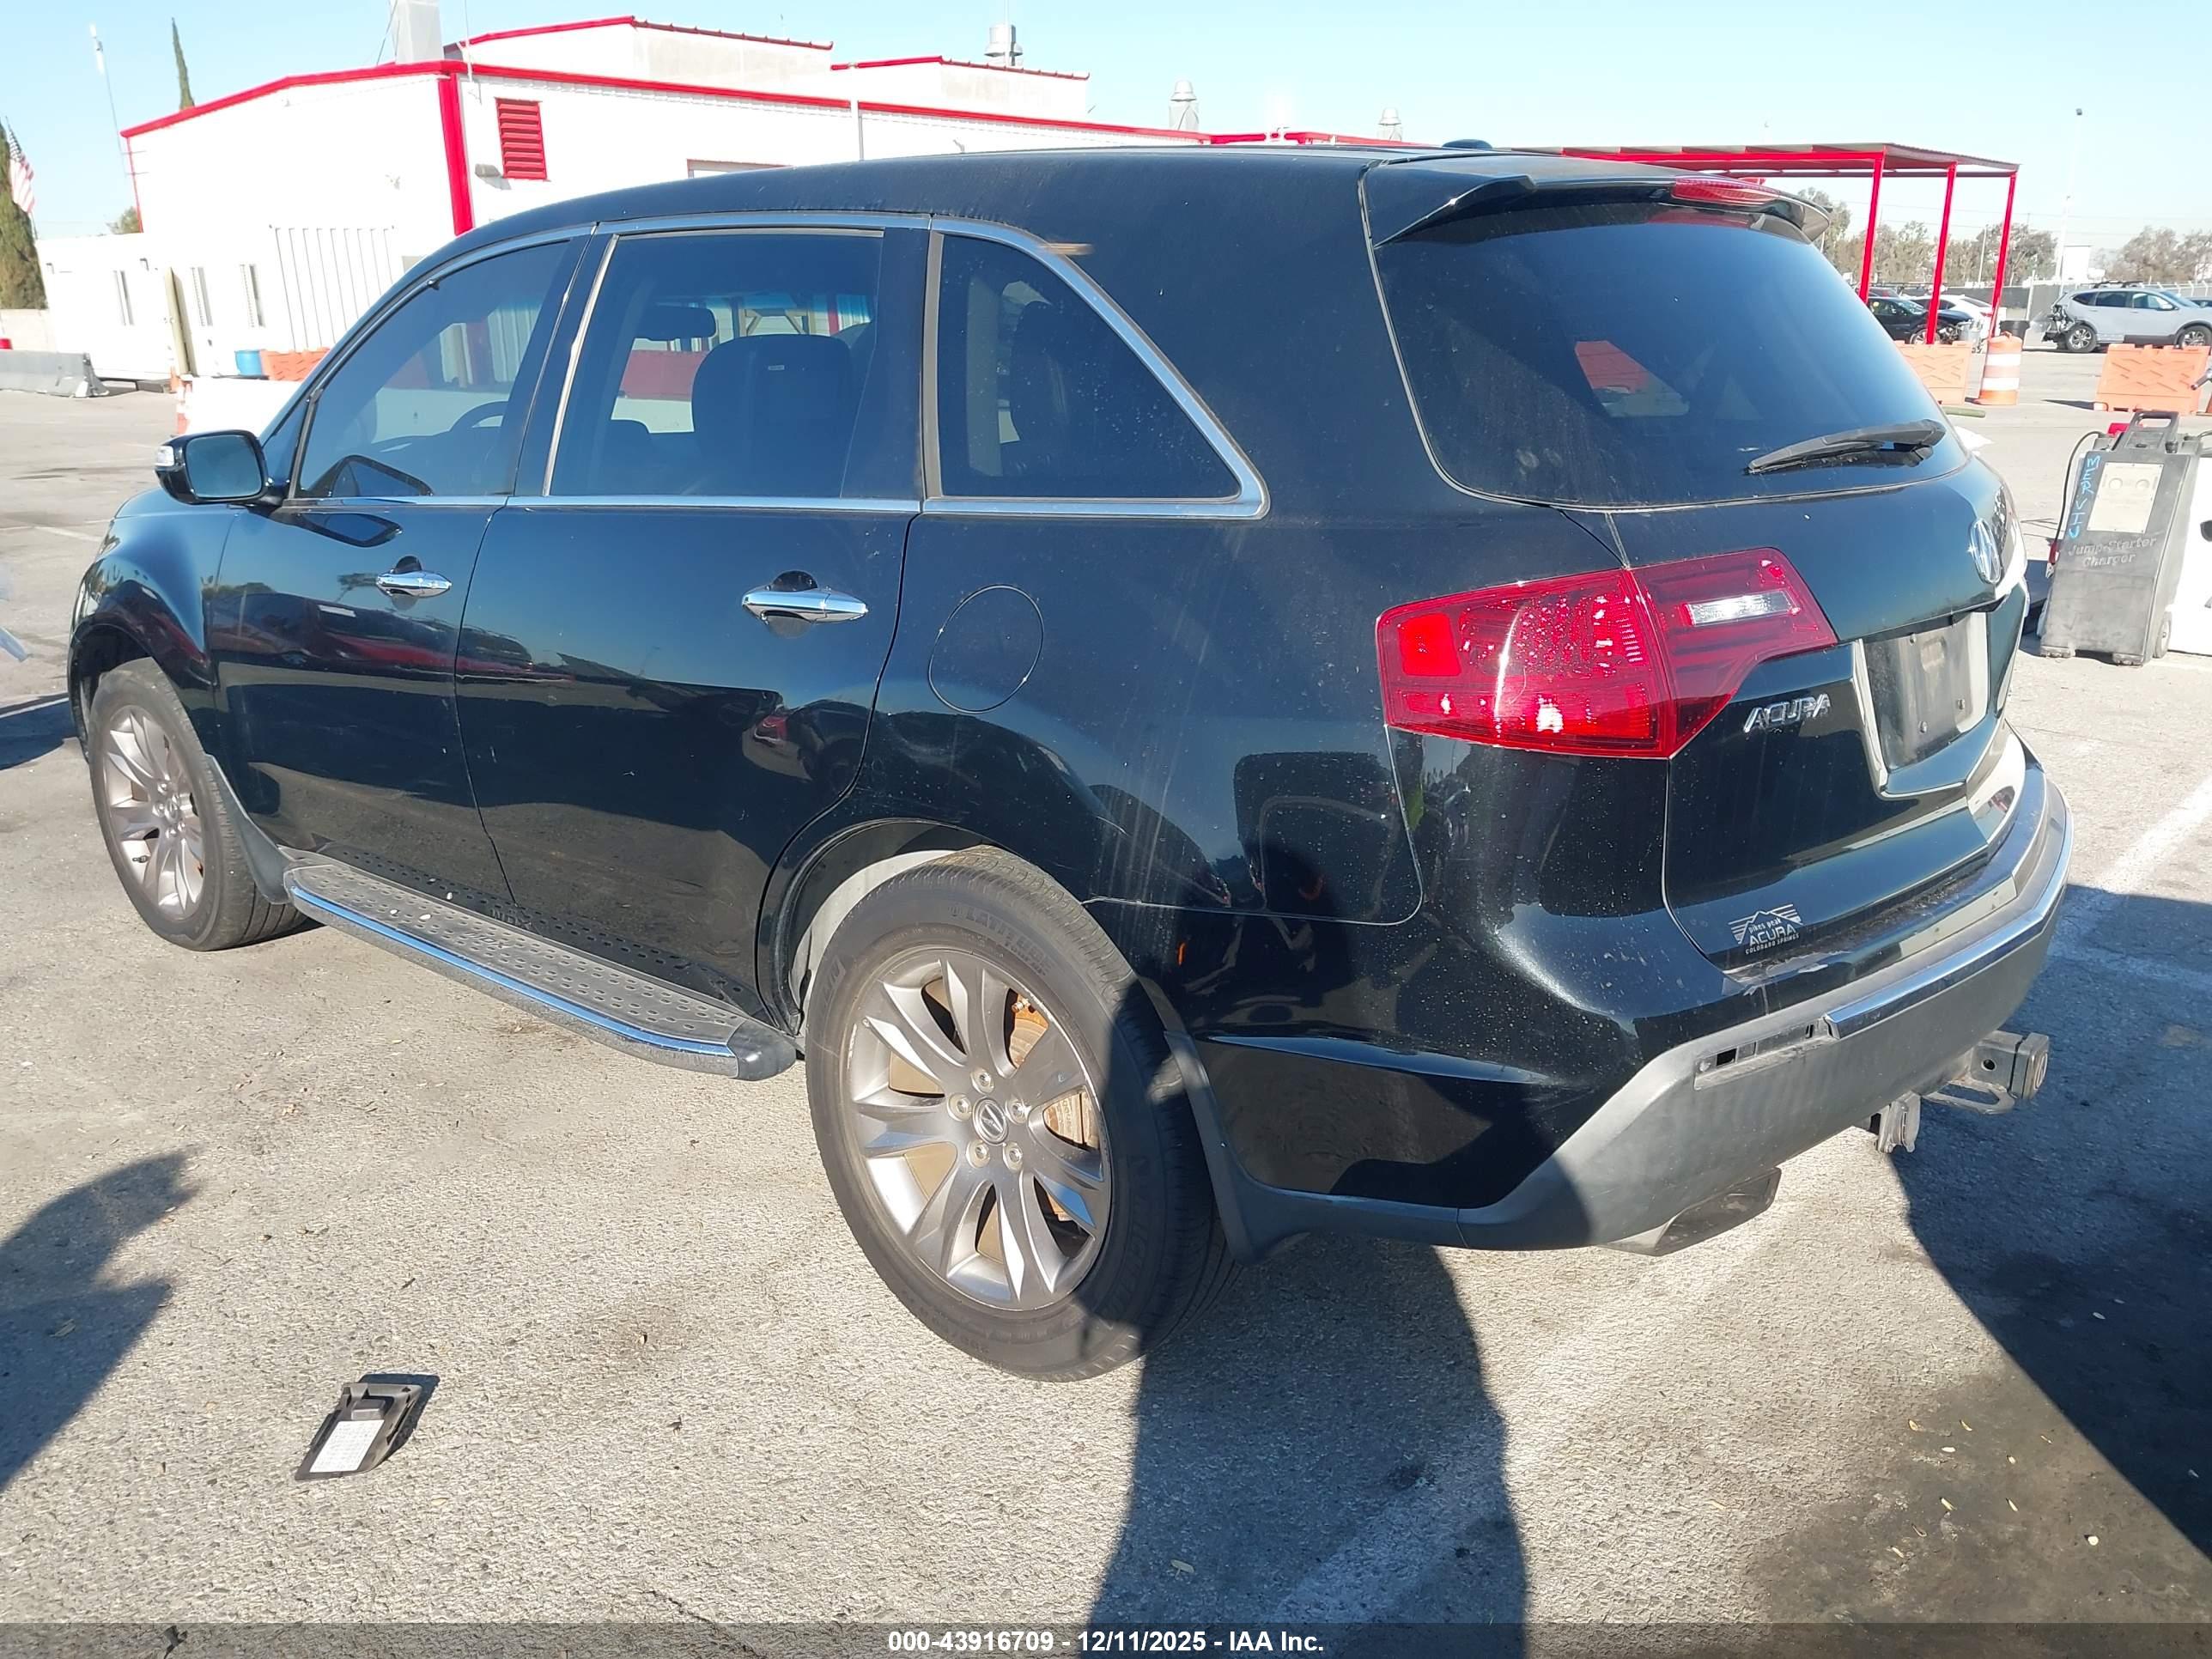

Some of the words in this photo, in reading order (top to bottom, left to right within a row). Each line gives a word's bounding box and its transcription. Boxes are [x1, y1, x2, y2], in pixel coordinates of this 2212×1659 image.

[1742, 693, 1832, 733] ACURA
[1745, 941, 1776, 955] COLORADO
[1777, 933, 1800, 945] SPRINGS
[1749, 923, 1796, 946] ACURA
